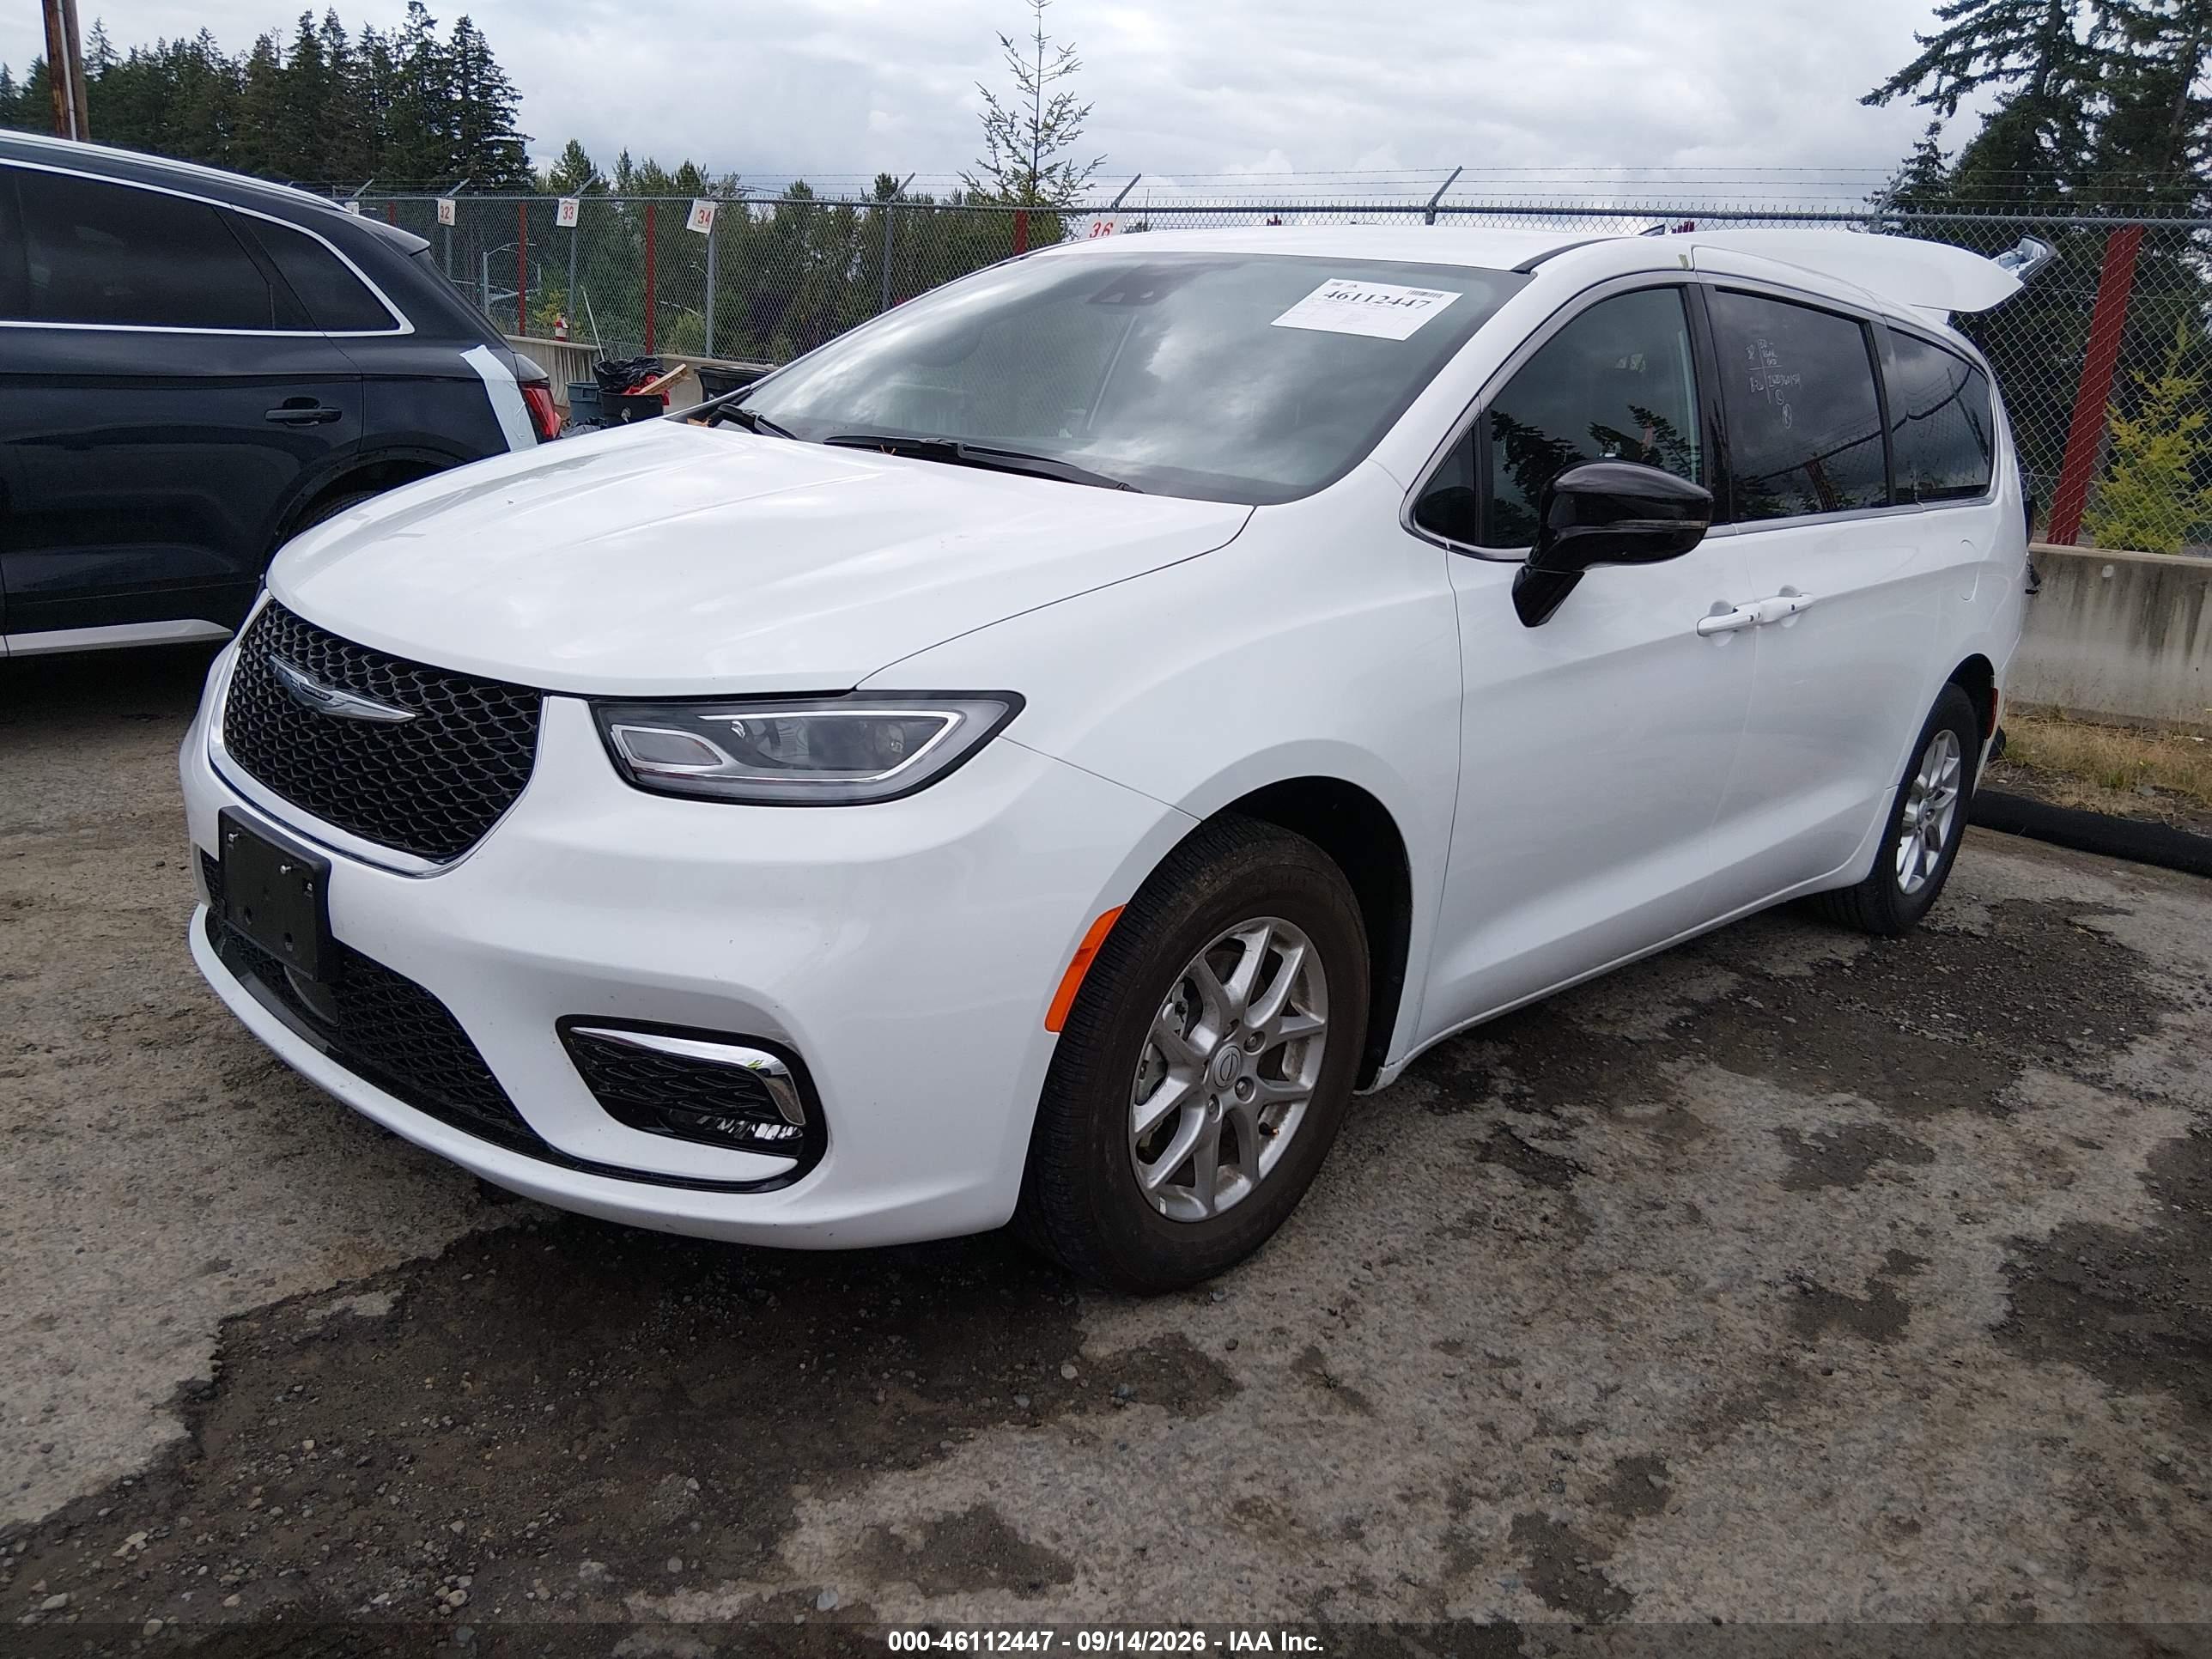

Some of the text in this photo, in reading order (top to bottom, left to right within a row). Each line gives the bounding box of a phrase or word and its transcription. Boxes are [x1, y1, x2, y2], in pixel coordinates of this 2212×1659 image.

[440, 205, 450, 219] 32
[563, 206, 574, 220] 33
[697, 209, 711, 225] 34
[1089, 222, 1114, 238] 36
[1323, 290, 1432, 309] 46112447
